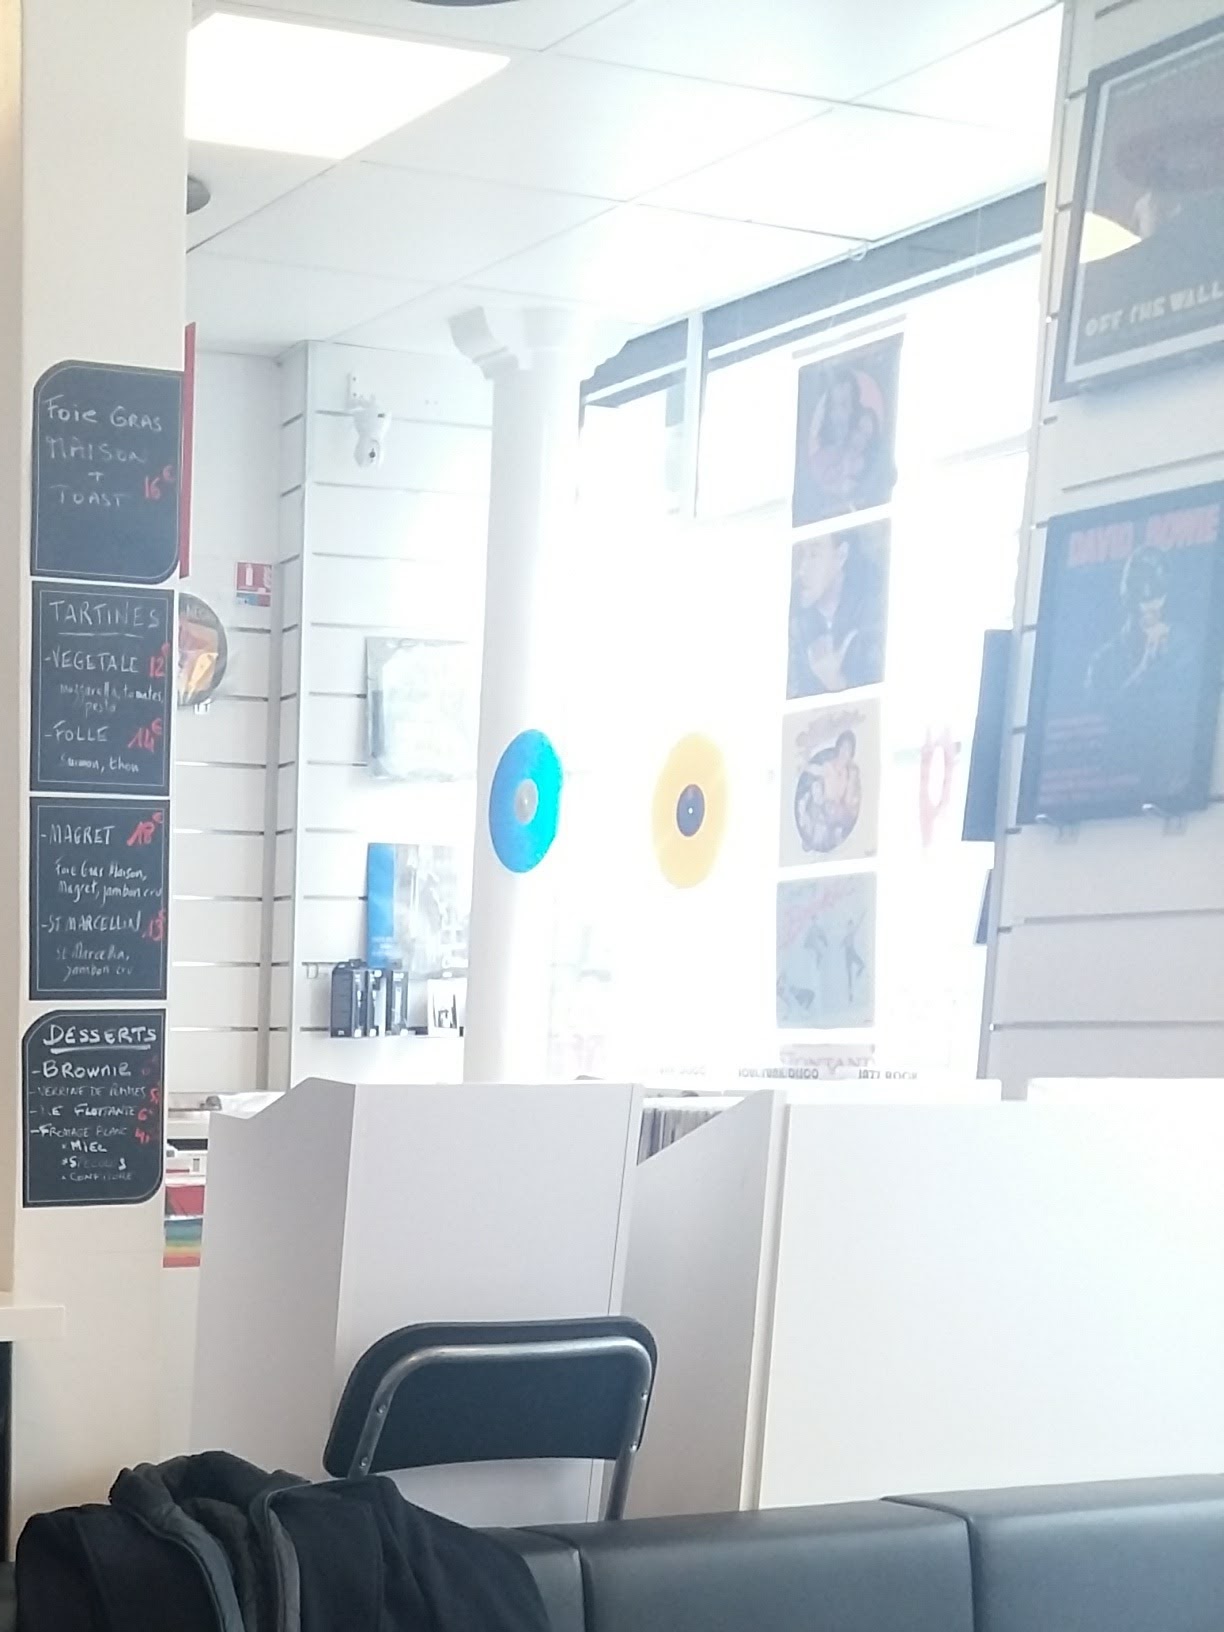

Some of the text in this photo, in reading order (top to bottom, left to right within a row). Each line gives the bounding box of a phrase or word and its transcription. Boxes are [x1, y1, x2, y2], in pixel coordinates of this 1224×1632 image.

[110, 406, 162, 432] GRAS
[49, 485, 127, 506] TOAST
[49, 601, 160, 628] TARTINES
[43, 1024, 157, 1045] DESSERTS
